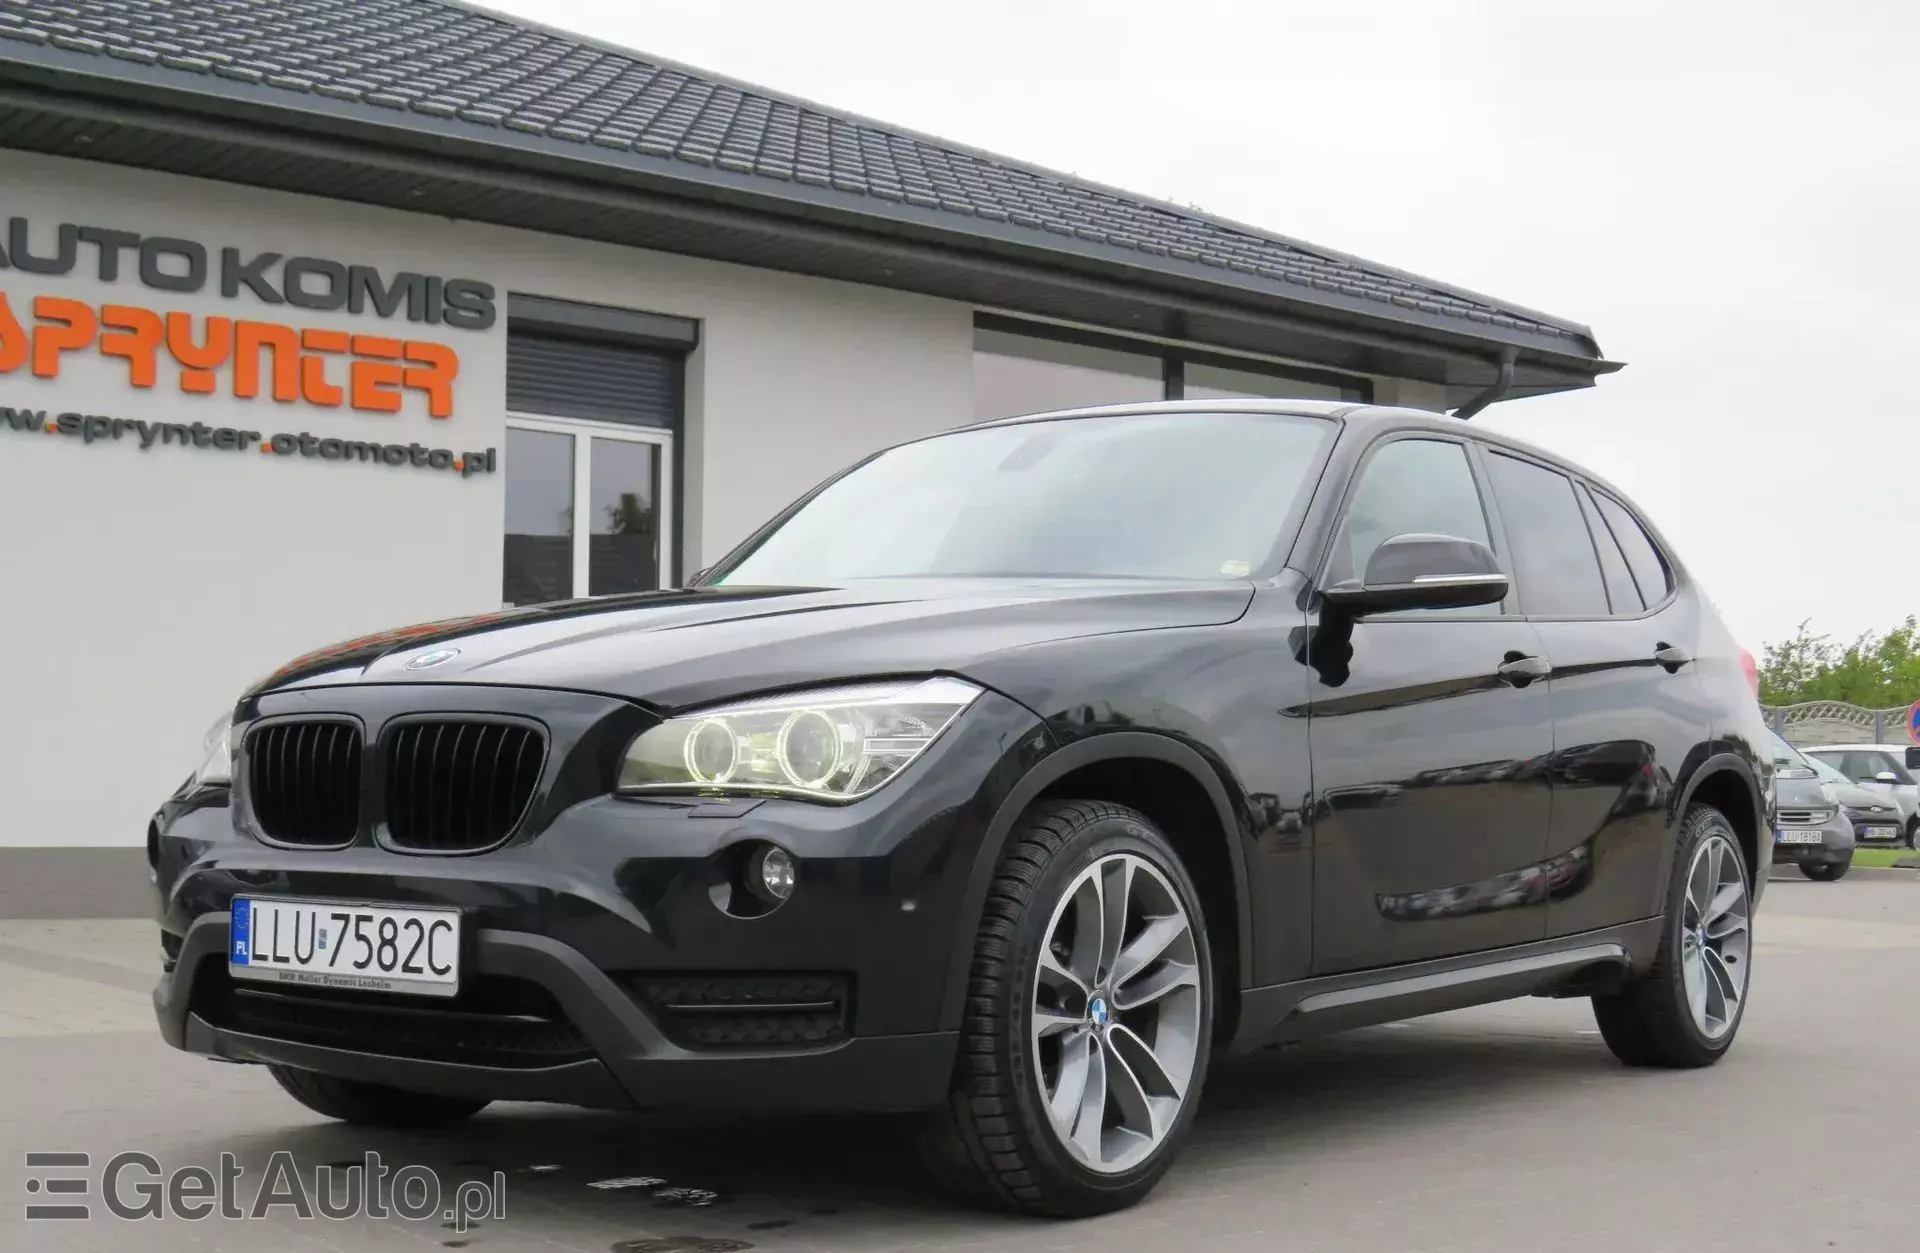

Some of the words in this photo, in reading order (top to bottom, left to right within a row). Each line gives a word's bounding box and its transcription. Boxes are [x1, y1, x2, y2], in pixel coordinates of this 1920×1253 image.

[0, 217, 207, 293] UTO
[221, 246, 497, 330] KOMIS
[0, 405, 497, 478] w.sprynter.otomoto.pl
[235, 940, 248, 956] PL
[251, 906, 316, 965] LLU
[328, 912, 453, 976] 7582C
